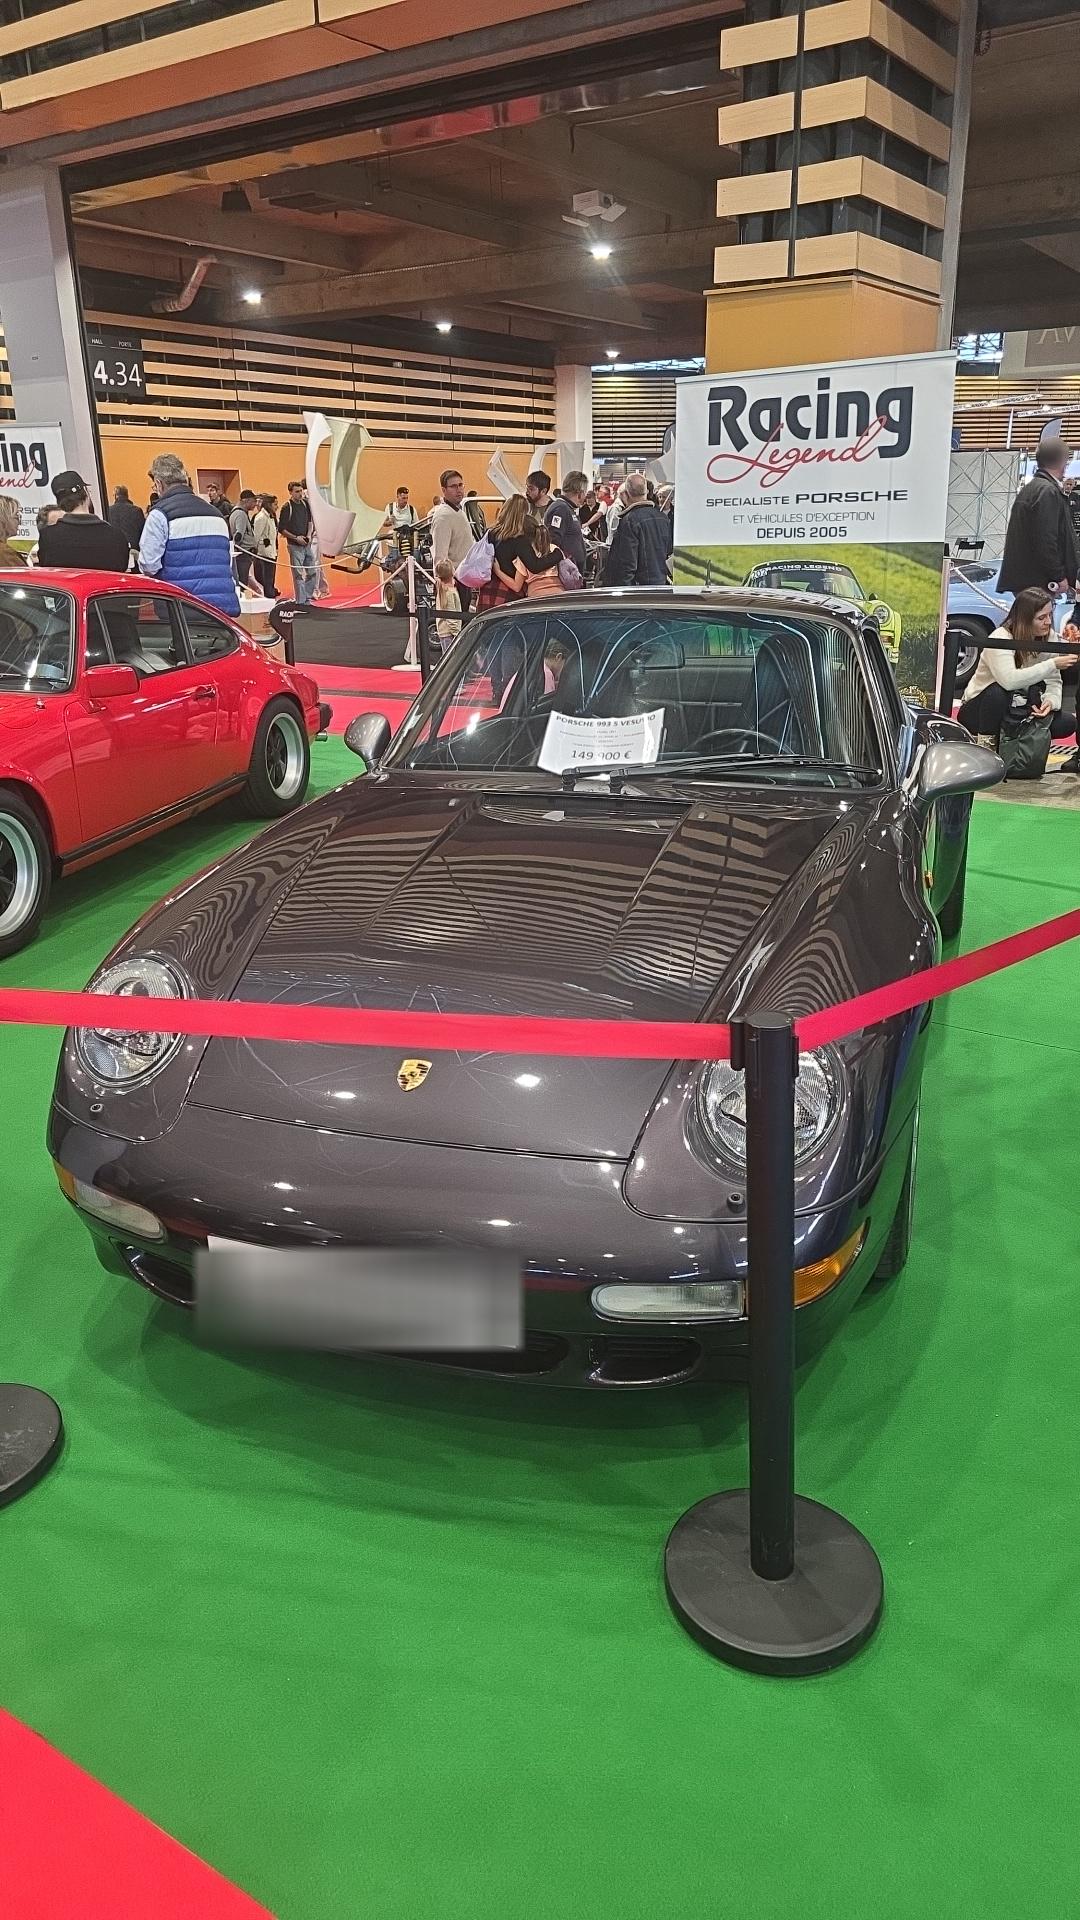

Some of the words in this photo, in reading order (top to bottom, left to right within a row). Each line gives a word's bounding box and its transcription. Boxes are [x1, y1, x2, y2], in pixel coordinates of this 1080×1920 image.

[94, 360, 142, 387] 4.34
[707, 377, 913, 458] Racing
[0, 433, 49, 487] ing
[707, 415, 888, 488] Legend
[706, 496, 790, 507] SPECIALISTE
[795, 490, 908, 504] PORSCHE
[733, 515, 745, 524] ET
[747, 512, 803, 524] VÉHICULES
[806, 511, 875, 522] D'EXCEPTION
[757, 527, 806, 538] DEPUIS
[809, 526, 847, 538] 2005
[556, 715, 594, 727] PORSCHE
[571, 750, 594, 760] 149
[624, 750, 632, 759] €
